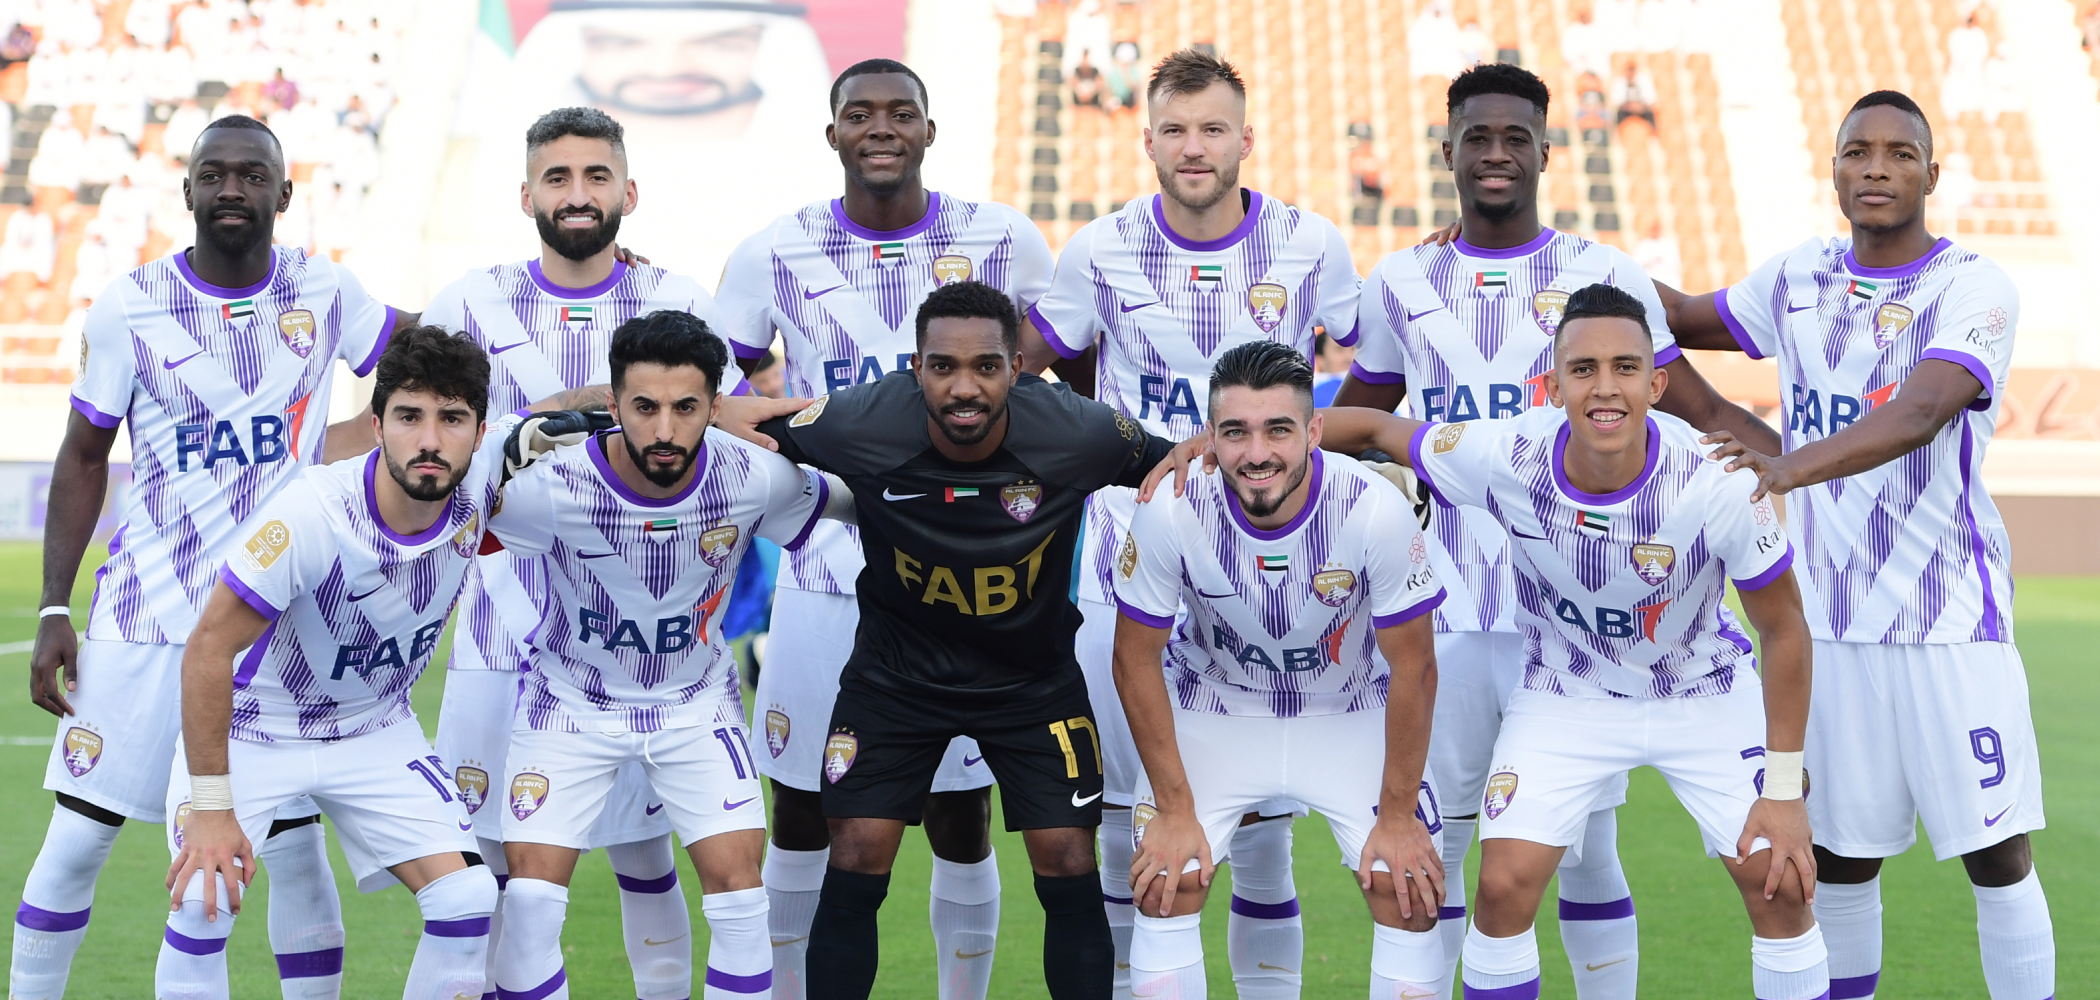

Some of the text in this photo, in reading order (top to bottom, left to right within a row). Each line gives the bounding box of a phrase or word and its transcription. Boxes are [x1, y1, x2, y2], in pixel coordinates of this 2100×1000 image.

[1890, 312, 1901, 320] AIN
[1965, 327, 1996, 360] Rain
[823, 353, 912, 396] FA
[1138, 374, 1203, 426] FA
[713, 533, 725, 541] AIN
[70, 733, 79, 742] AL
[78, 736, 90, 745] AIN
[89, 740, 98, 748] FC
[708, 727, 758, 780] 11
[1049, 716, 1103, 779] 17
[1969, 727, 2006, 789] 9
[522, 780, 534, 788] AIN
